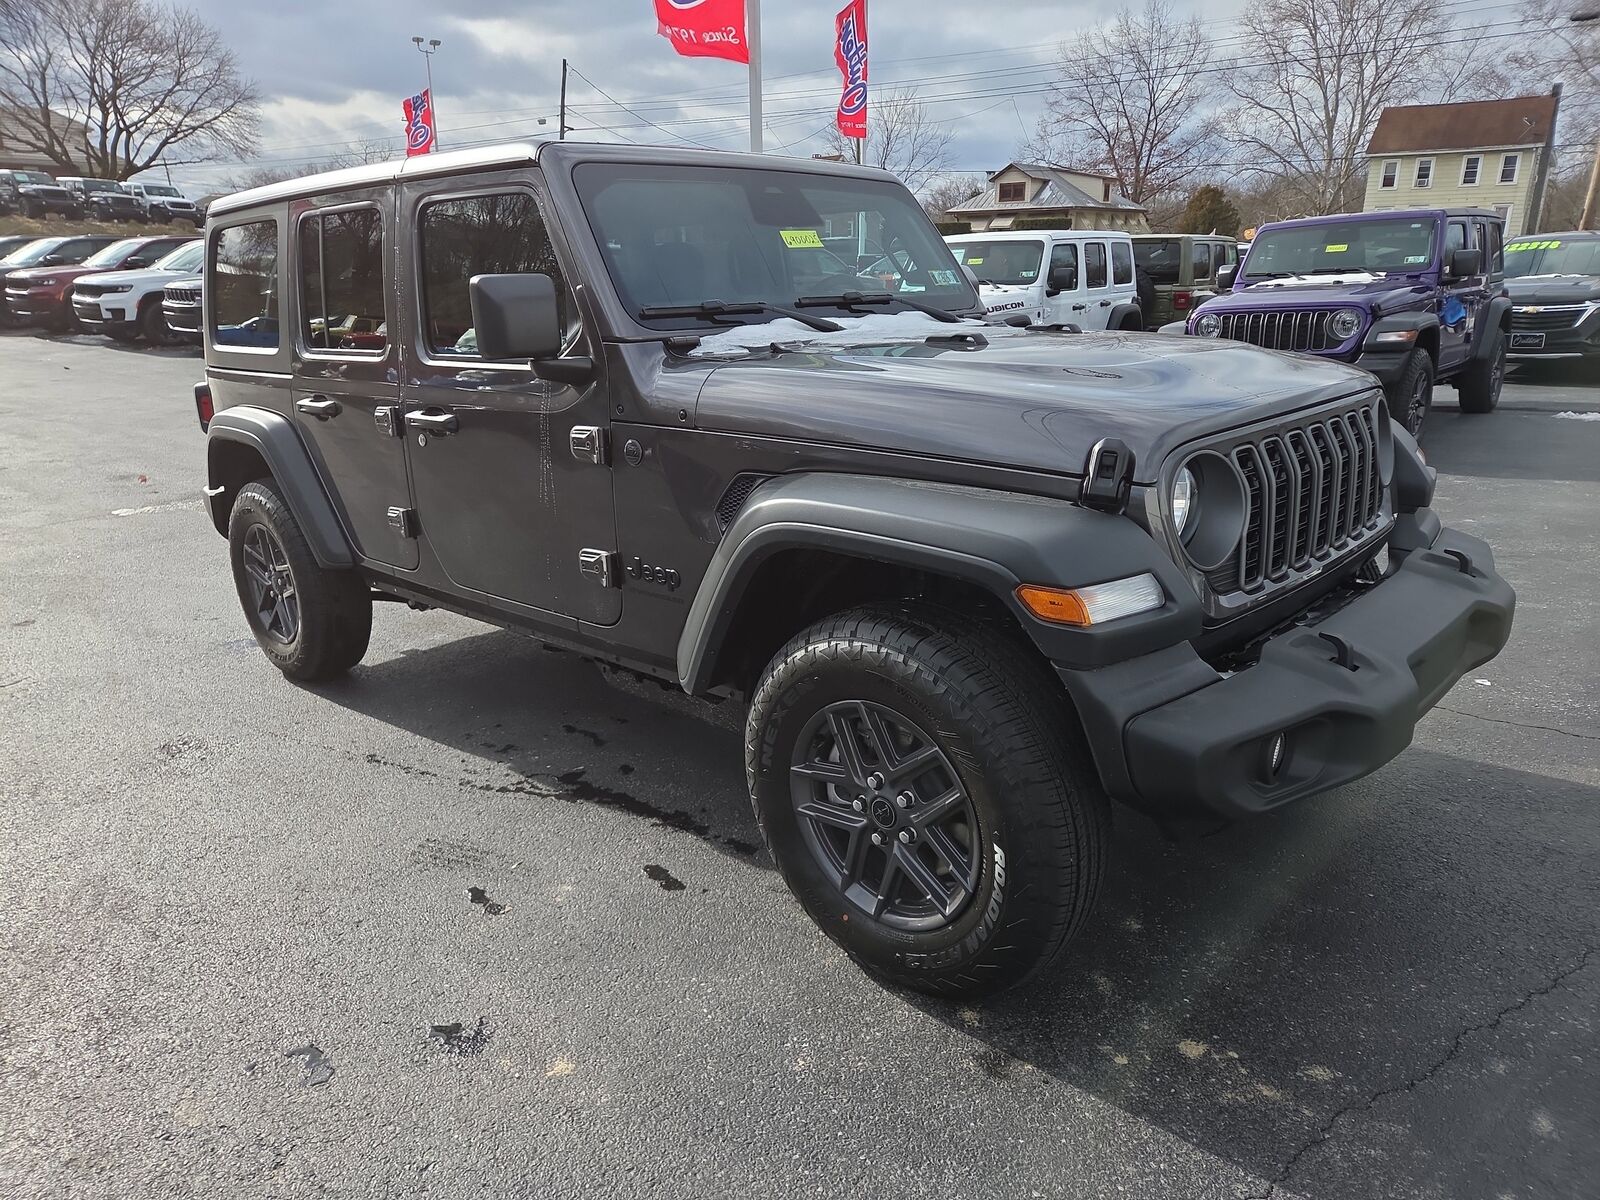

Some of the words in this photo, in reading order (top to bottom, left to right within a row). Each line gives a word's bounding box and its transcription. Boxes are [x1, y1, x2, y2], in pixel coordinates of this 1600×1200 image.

[985, 301, 1025, 314] UBICON
[626, 556, 682, 592] Jeep
[966, 842, 1007, 954] ROADIAN
